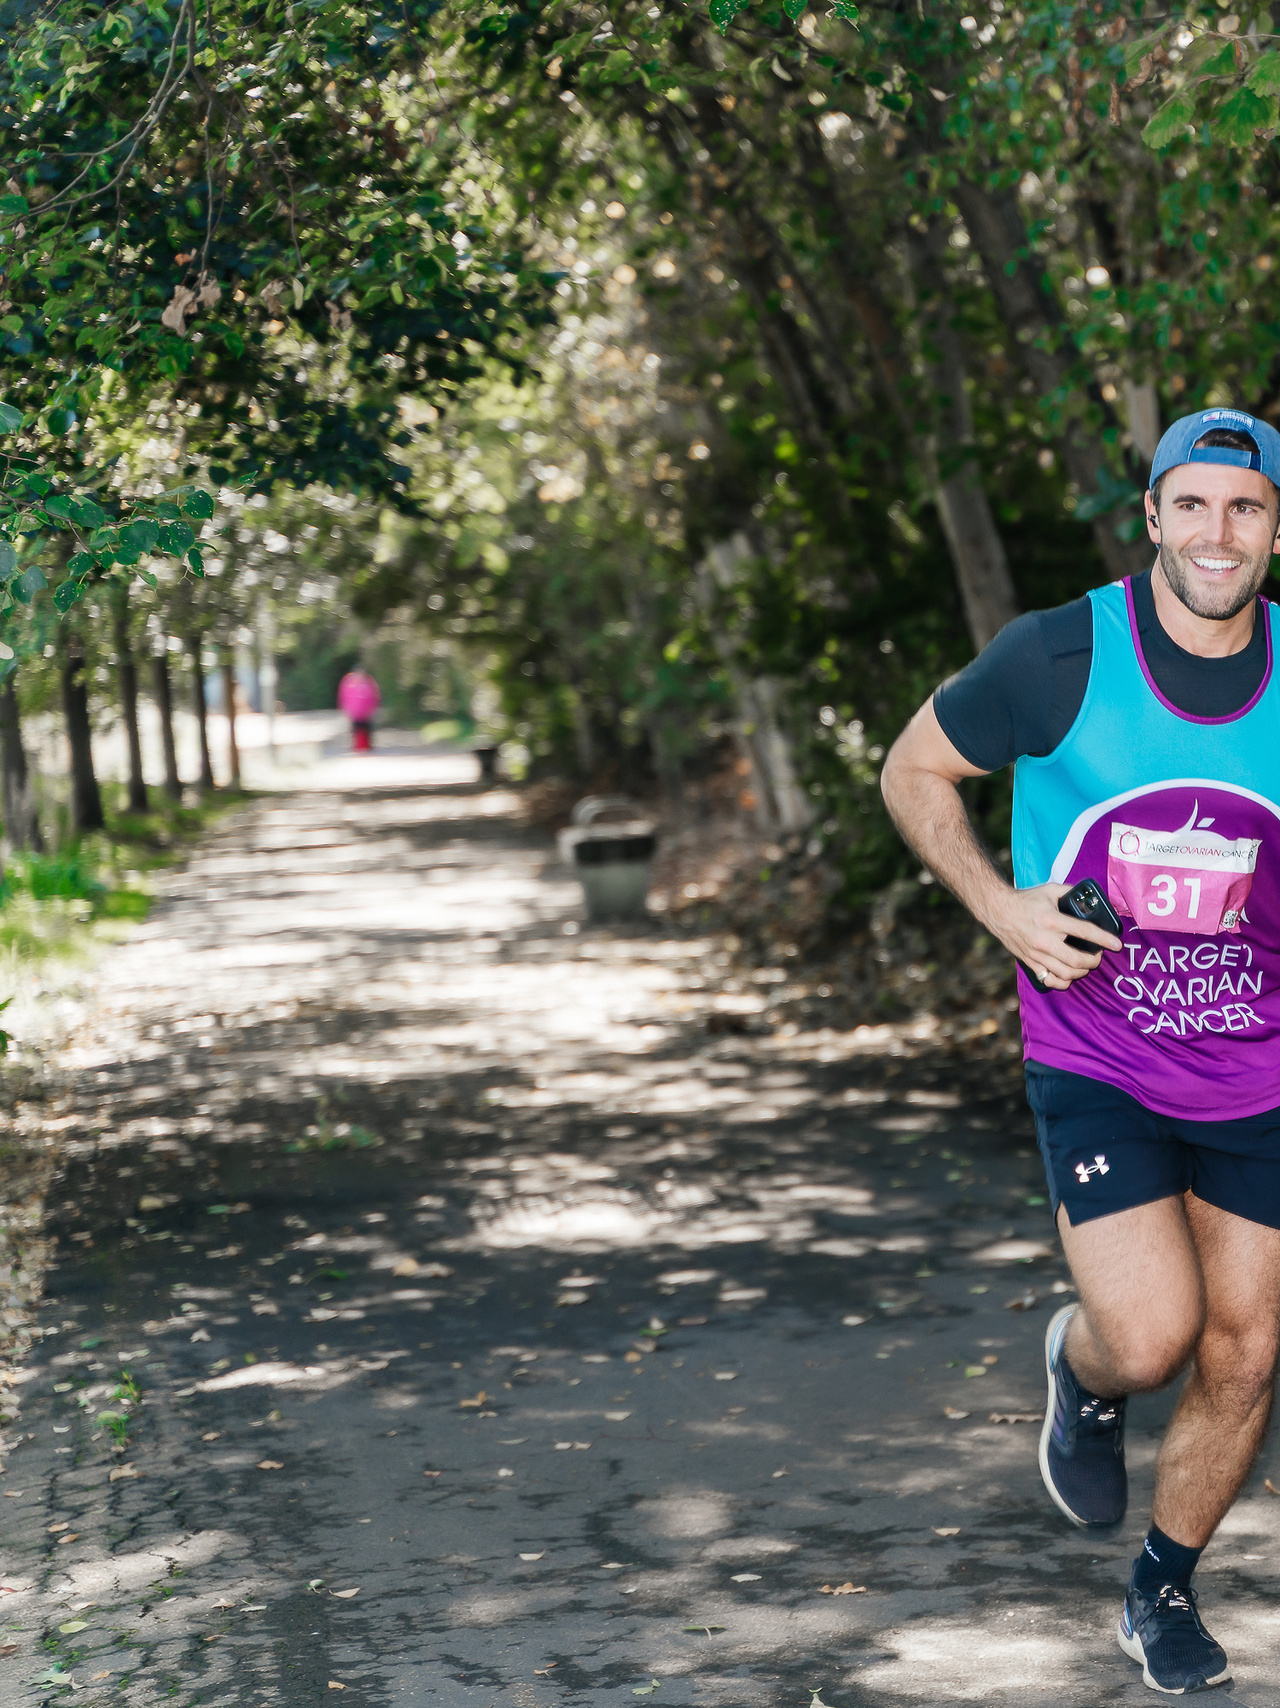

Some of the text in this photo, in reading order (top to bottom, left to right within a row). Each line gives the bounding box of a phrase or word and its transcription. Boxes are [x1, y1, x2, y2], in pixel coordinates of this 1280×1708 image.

[1145, 841, 1254, 860] TARGET OVARIAN CANCR
[1147, 873, 1202, 919] 31
[1113, 970, 1264, 1007] OVARIAN
[1127, 1002, 1266, 1036] CANCER
